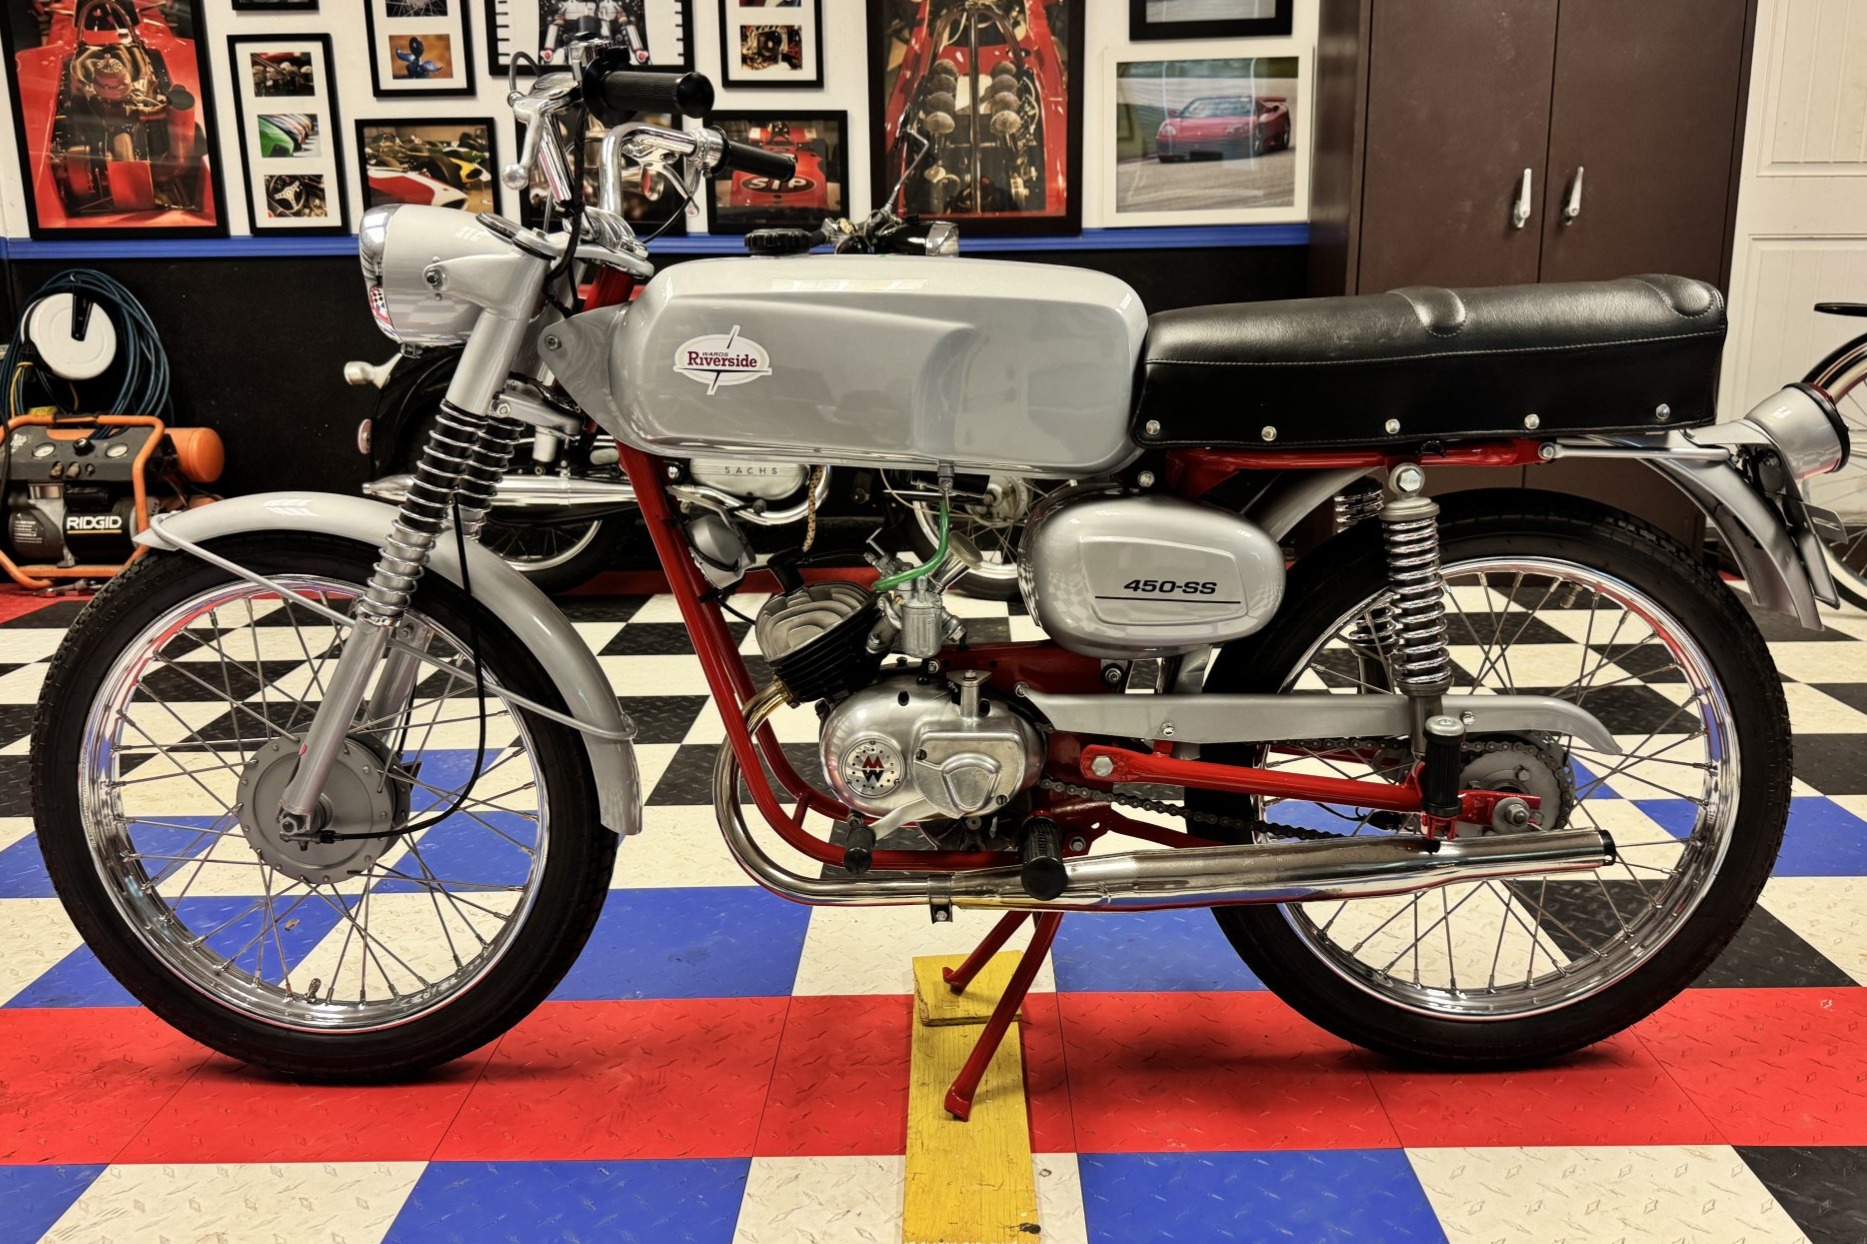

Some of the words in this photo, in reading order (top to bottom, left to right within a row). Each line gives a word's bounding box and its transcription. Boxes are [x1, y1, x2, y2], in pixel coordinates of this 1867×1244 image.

[687, 351, 757, 367] Riverside
[724, 466, 778, 475] SACHS
[66, 516, 122, 529] RIDGID
[1123, 579, 1217, 594] 450-SS
